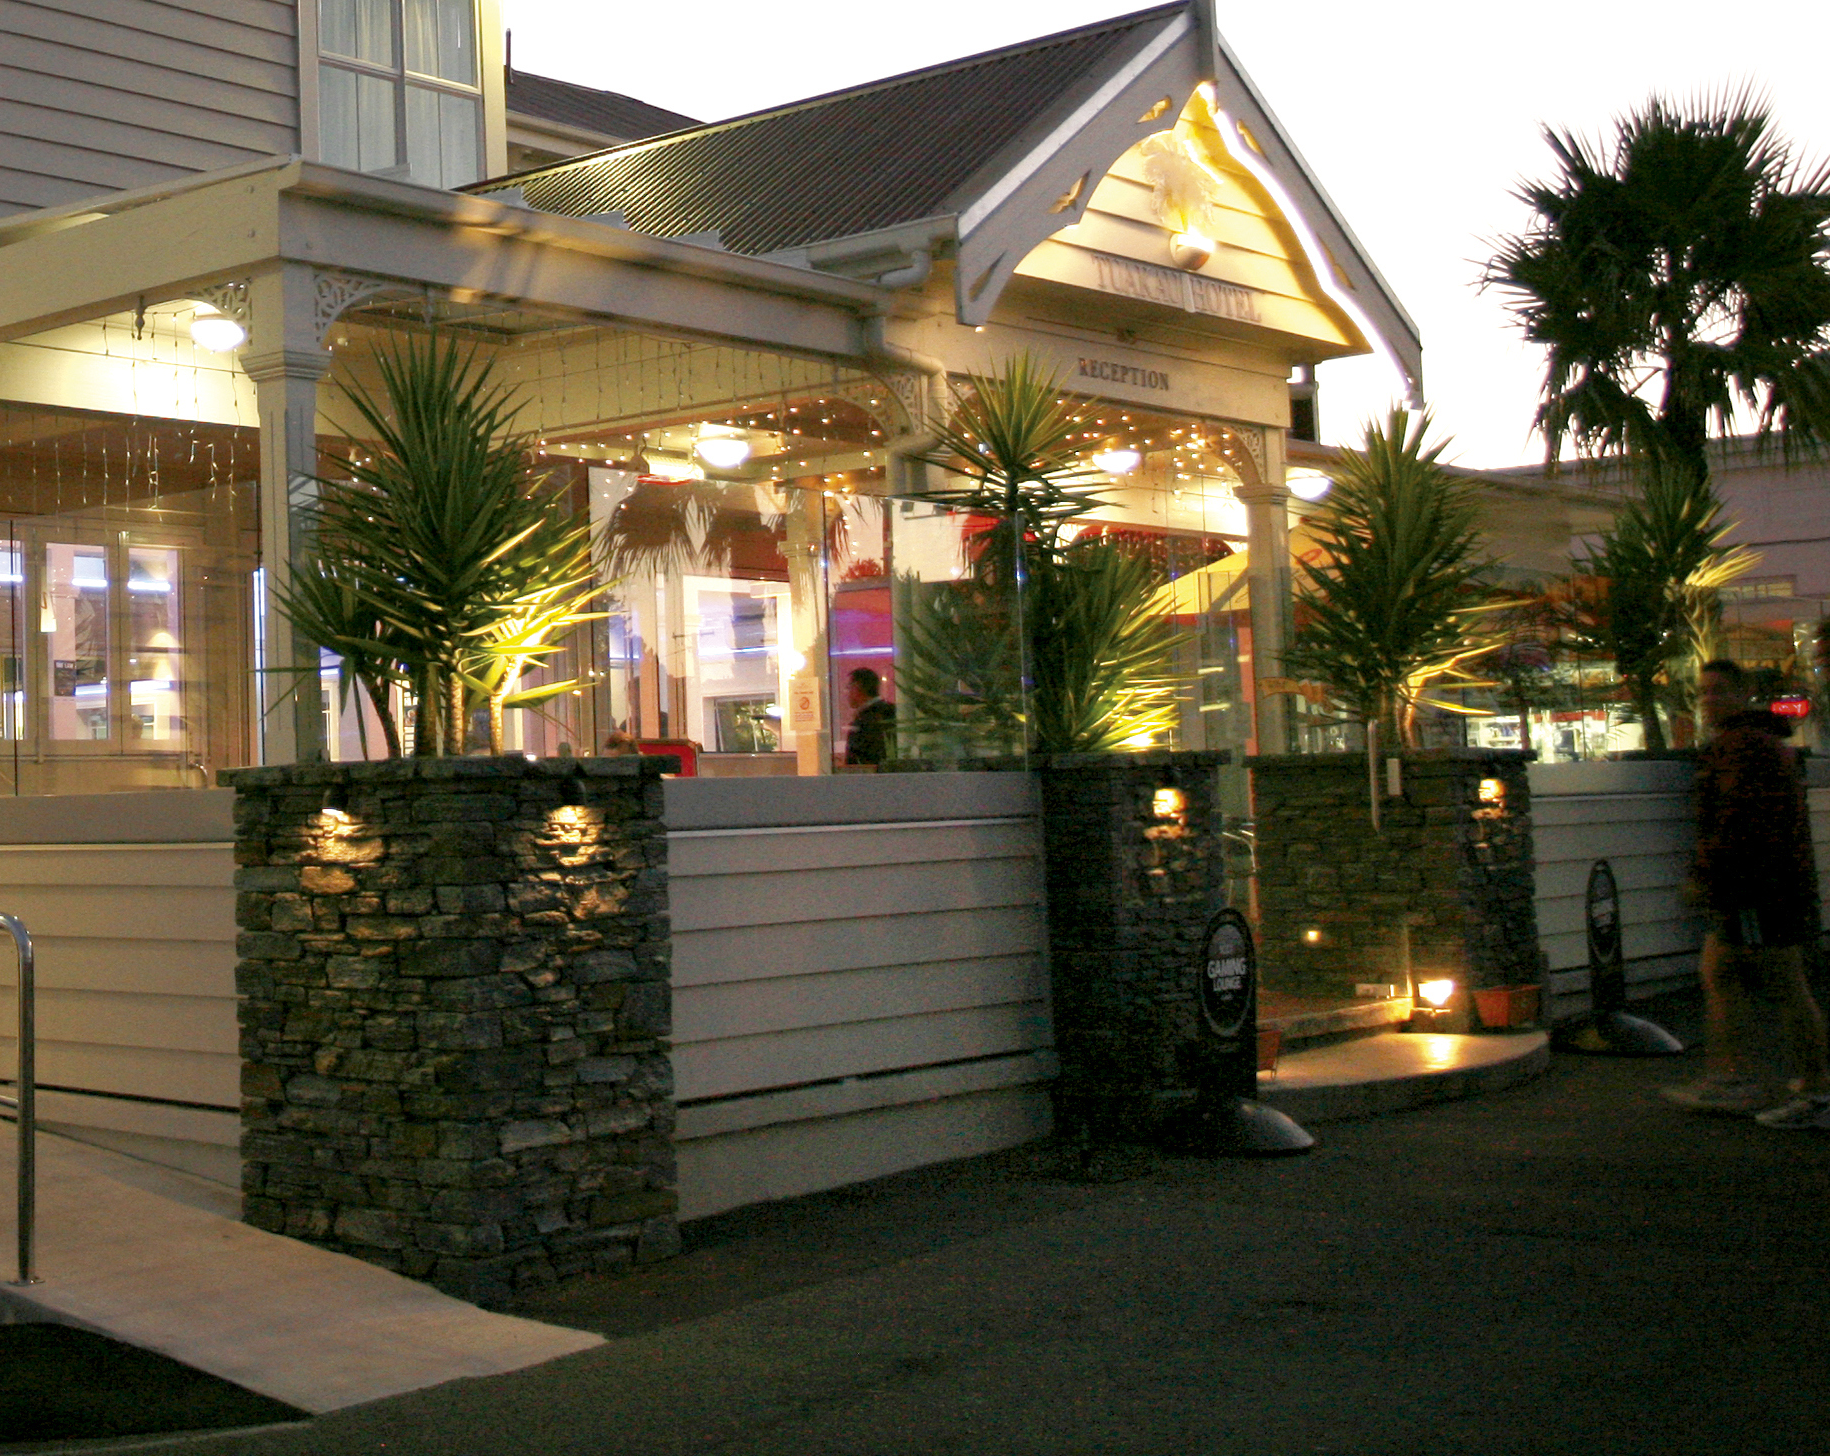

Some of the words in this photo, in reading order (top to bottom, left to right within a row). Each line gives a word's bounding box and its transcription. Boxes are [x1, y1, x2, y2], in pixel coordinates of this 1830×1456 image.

[1092, 255, 1182, 304] TUAKAU
[1188, 277, 1262, 323] HOTEL
[1078, 357, 1170, 392] RECEPTION
[1208, 958, 1247, 979] GAMING
